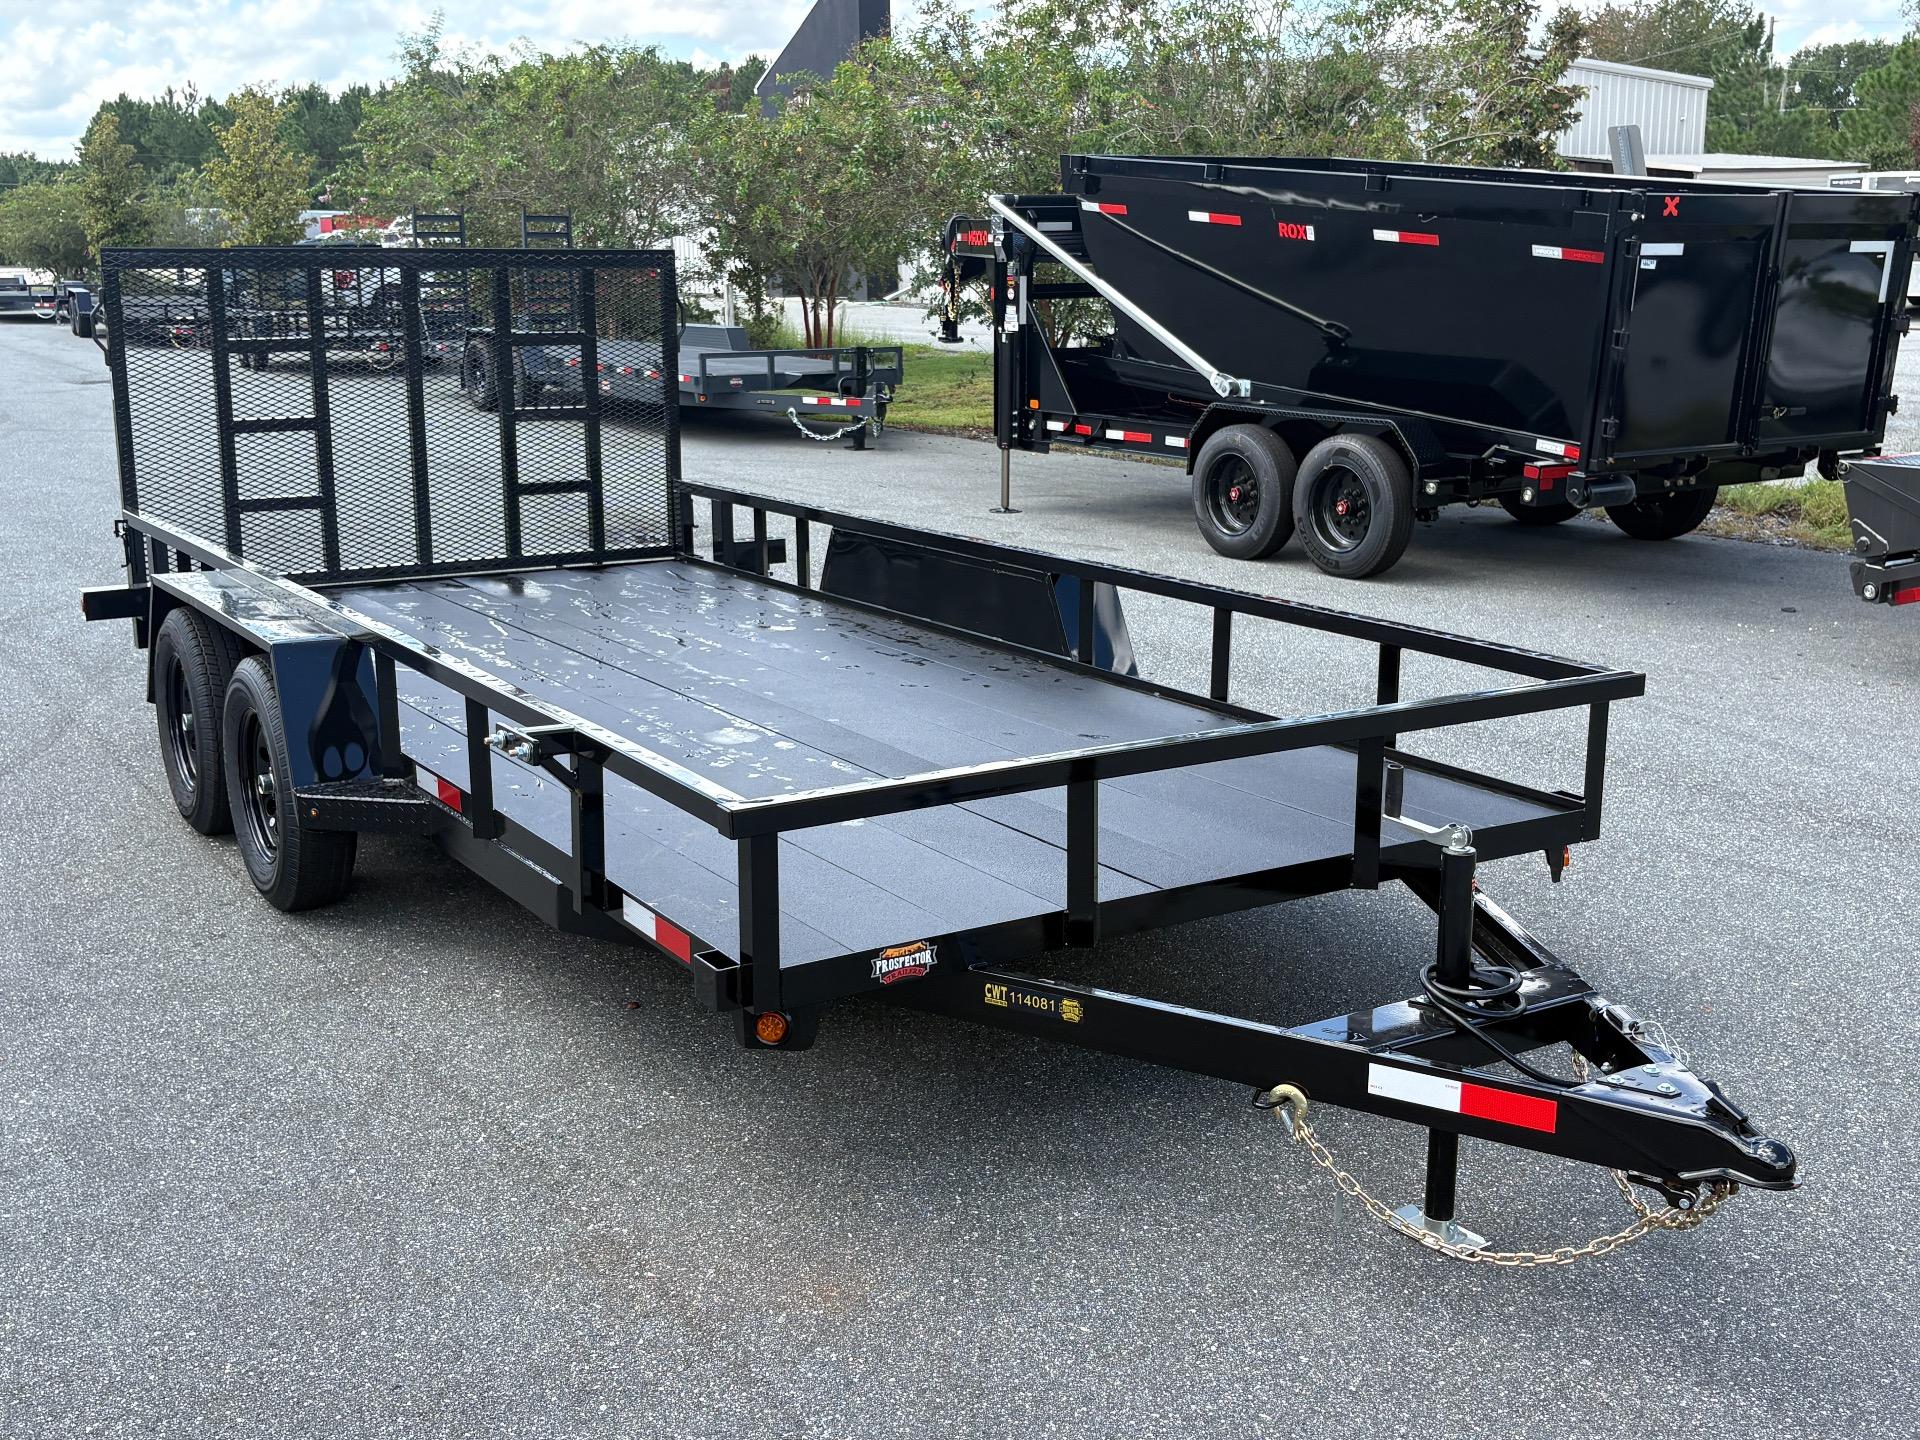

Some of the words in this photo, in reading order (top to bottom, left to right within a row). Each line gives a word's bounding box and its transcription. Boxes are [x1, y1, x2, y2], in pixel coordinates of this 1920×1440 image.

[875, 949, 932, 975] PROSPECTOR
[886, 968, 922, 982] TRAILERS
[985, 983, 1008, 1001] CWT
[1009, 991, 1055, 1011] 114081
